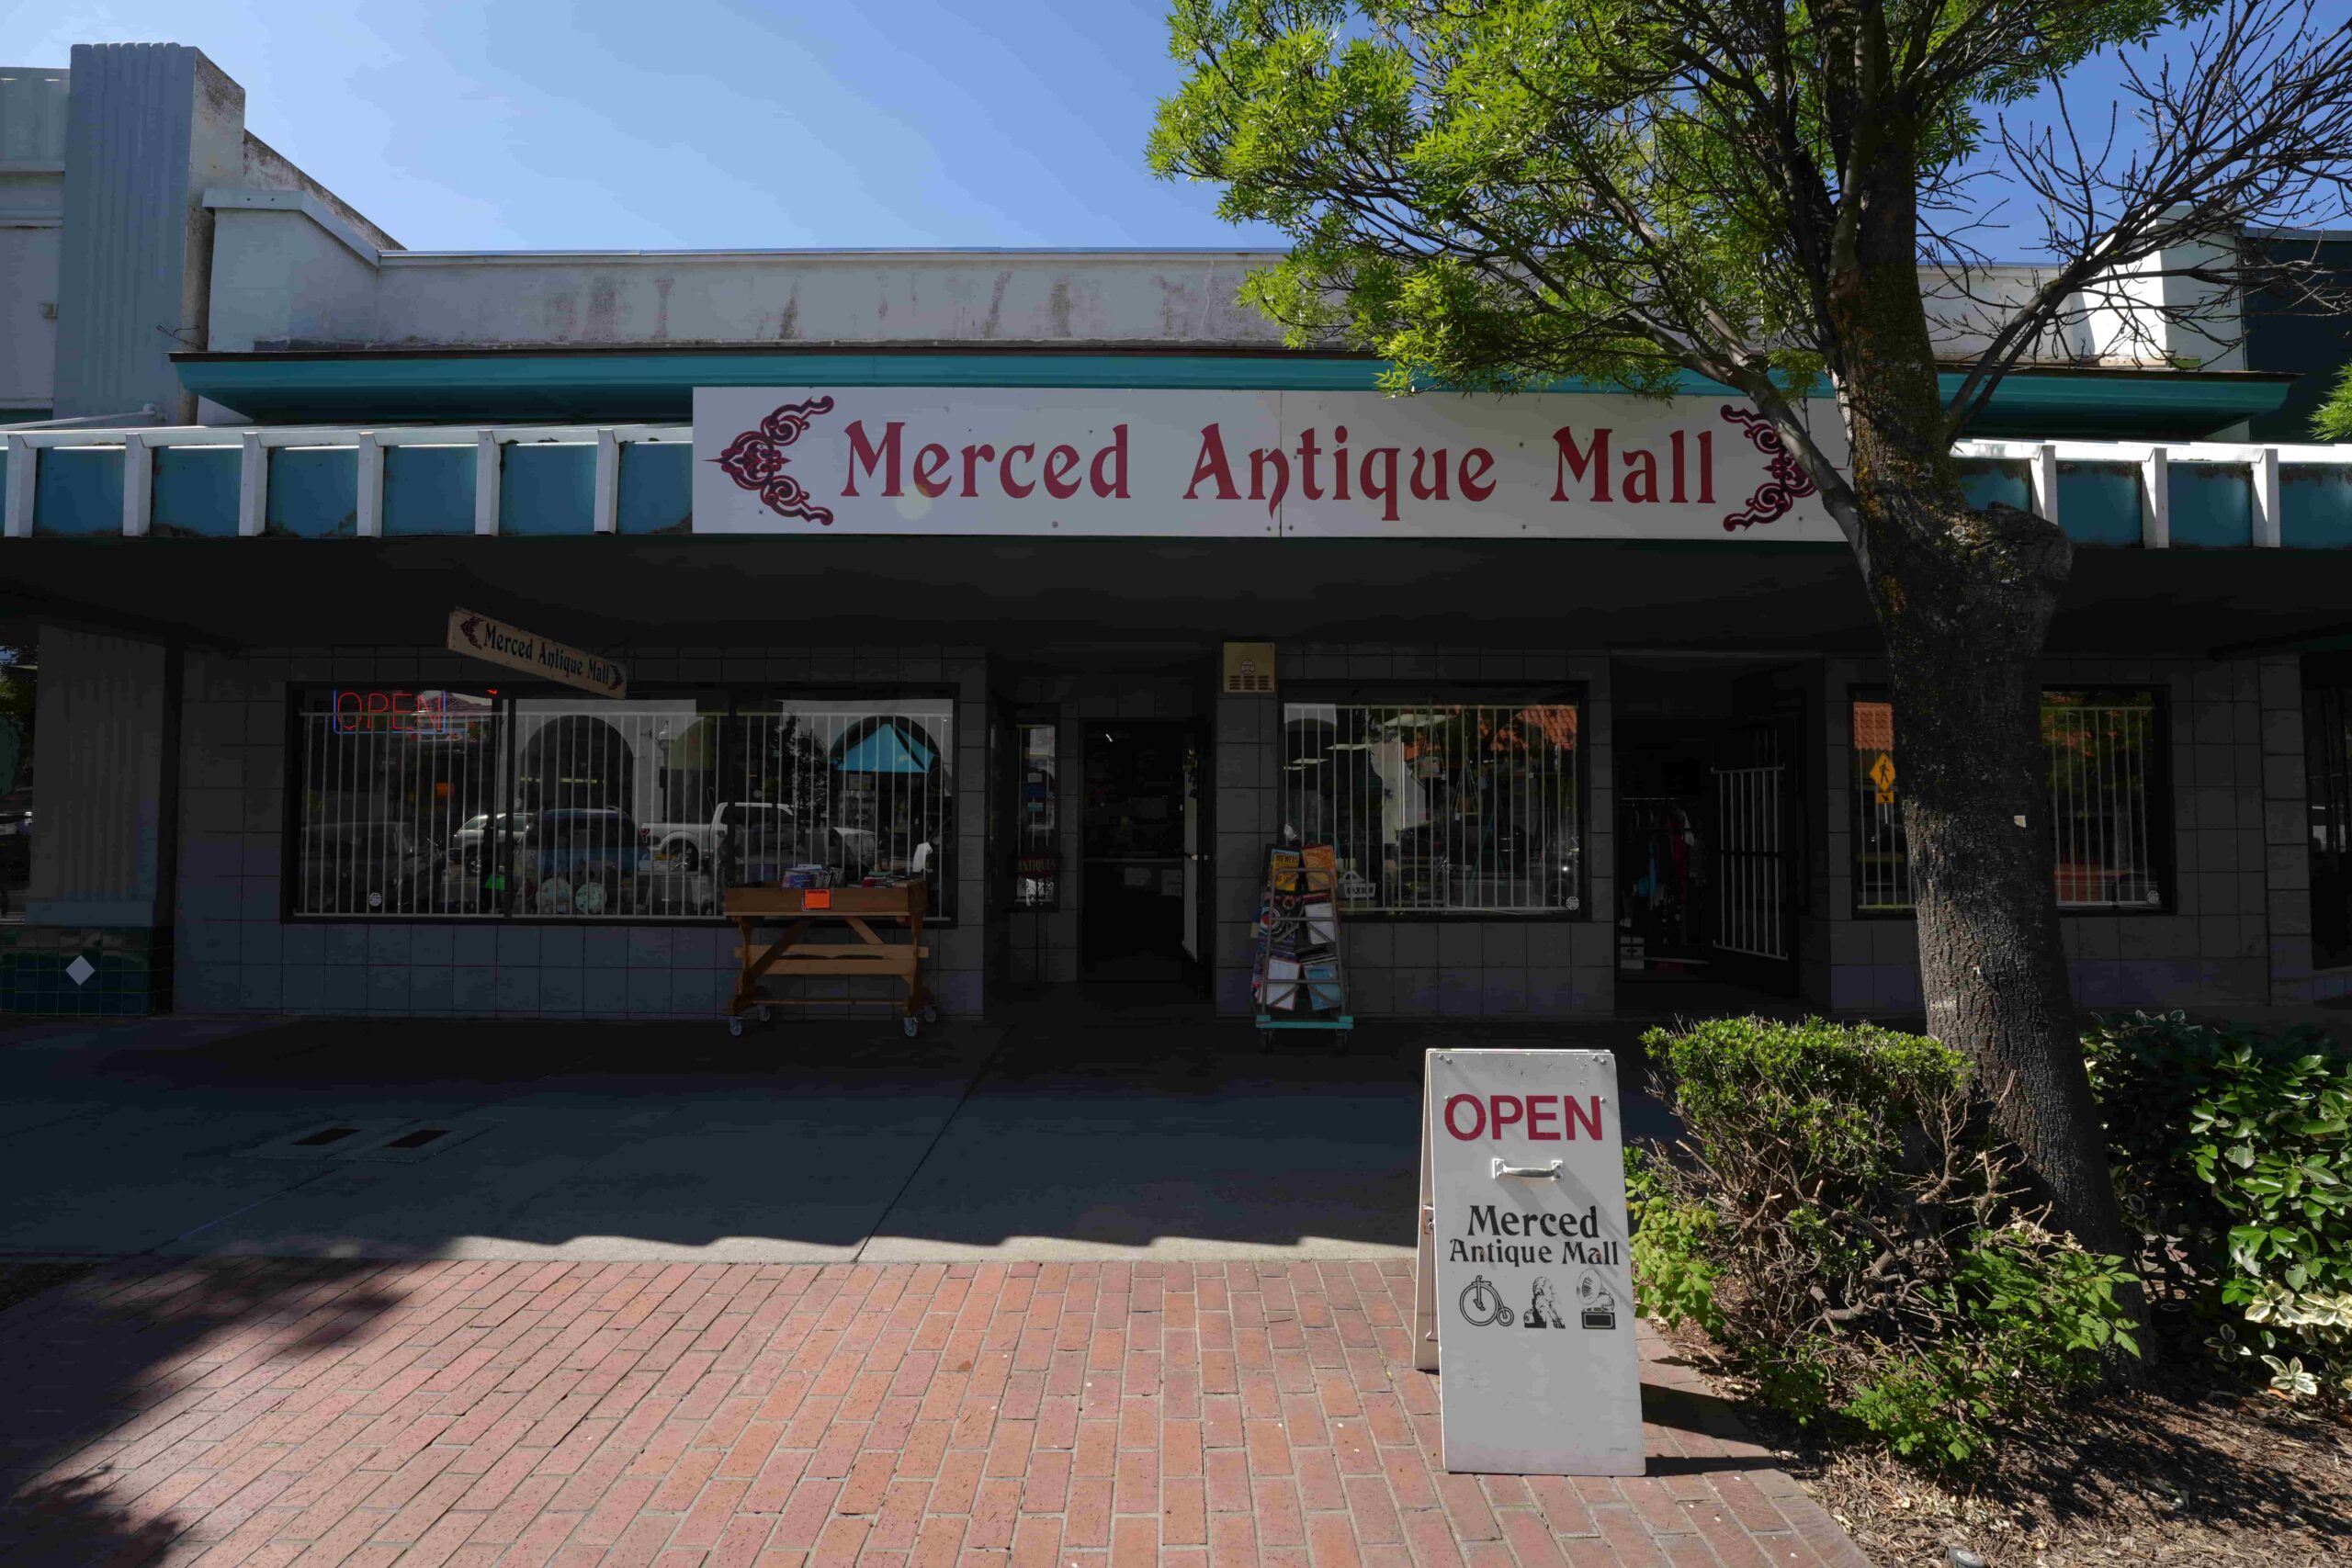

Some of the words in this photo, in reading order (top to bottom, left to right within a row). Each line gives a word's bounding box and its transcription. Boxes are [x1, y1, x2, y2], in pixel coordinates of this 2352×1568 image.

[841, 420, 1131, 500] Merced
[1182, 423, 1497, 521] Antique
[1550, 426, 1717, 504] Mall
[483, 623, 533, 660] Merced
[537, 642, 582, 678] Antique
[587, 659, 610, 684] Mall
[337, 690, 442, 731] OPEN
[1444, 1093, 1603, 1142] OPEN
[1467, 1204, 1600, 1239] Merced
[1449, 1238, 1553, 1268] Antique
[1562, 1240, 1620, 1266] Mall
